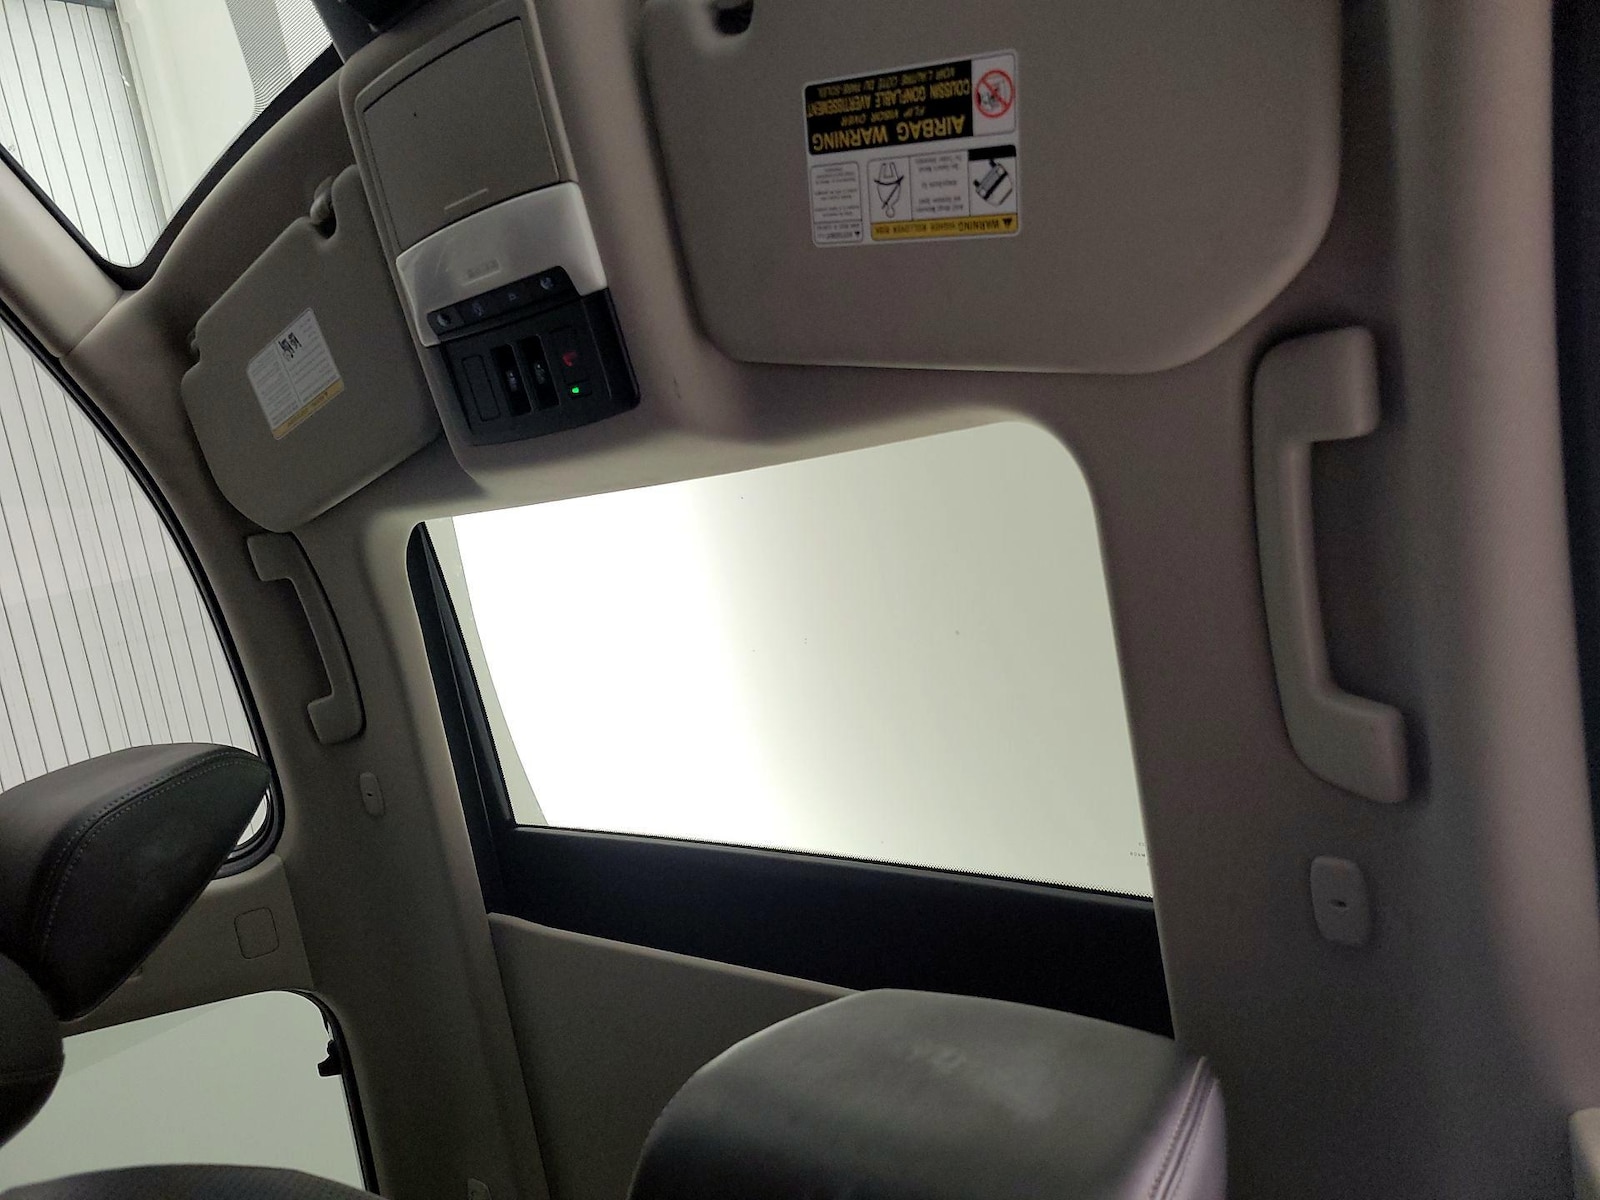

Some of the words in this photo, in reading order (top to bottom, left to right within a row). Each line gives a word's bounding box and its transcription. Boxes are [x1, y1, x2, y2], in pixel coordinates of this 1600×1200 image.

[874, 86, 926, 108] GONFLABLE
[929, 78, 970, 100] COUSSIN
[812, 125, 889, 151] WARNING
[897, 114, 966, 141] AIRBAG
[958, 219, 1000, 232] WARNING
